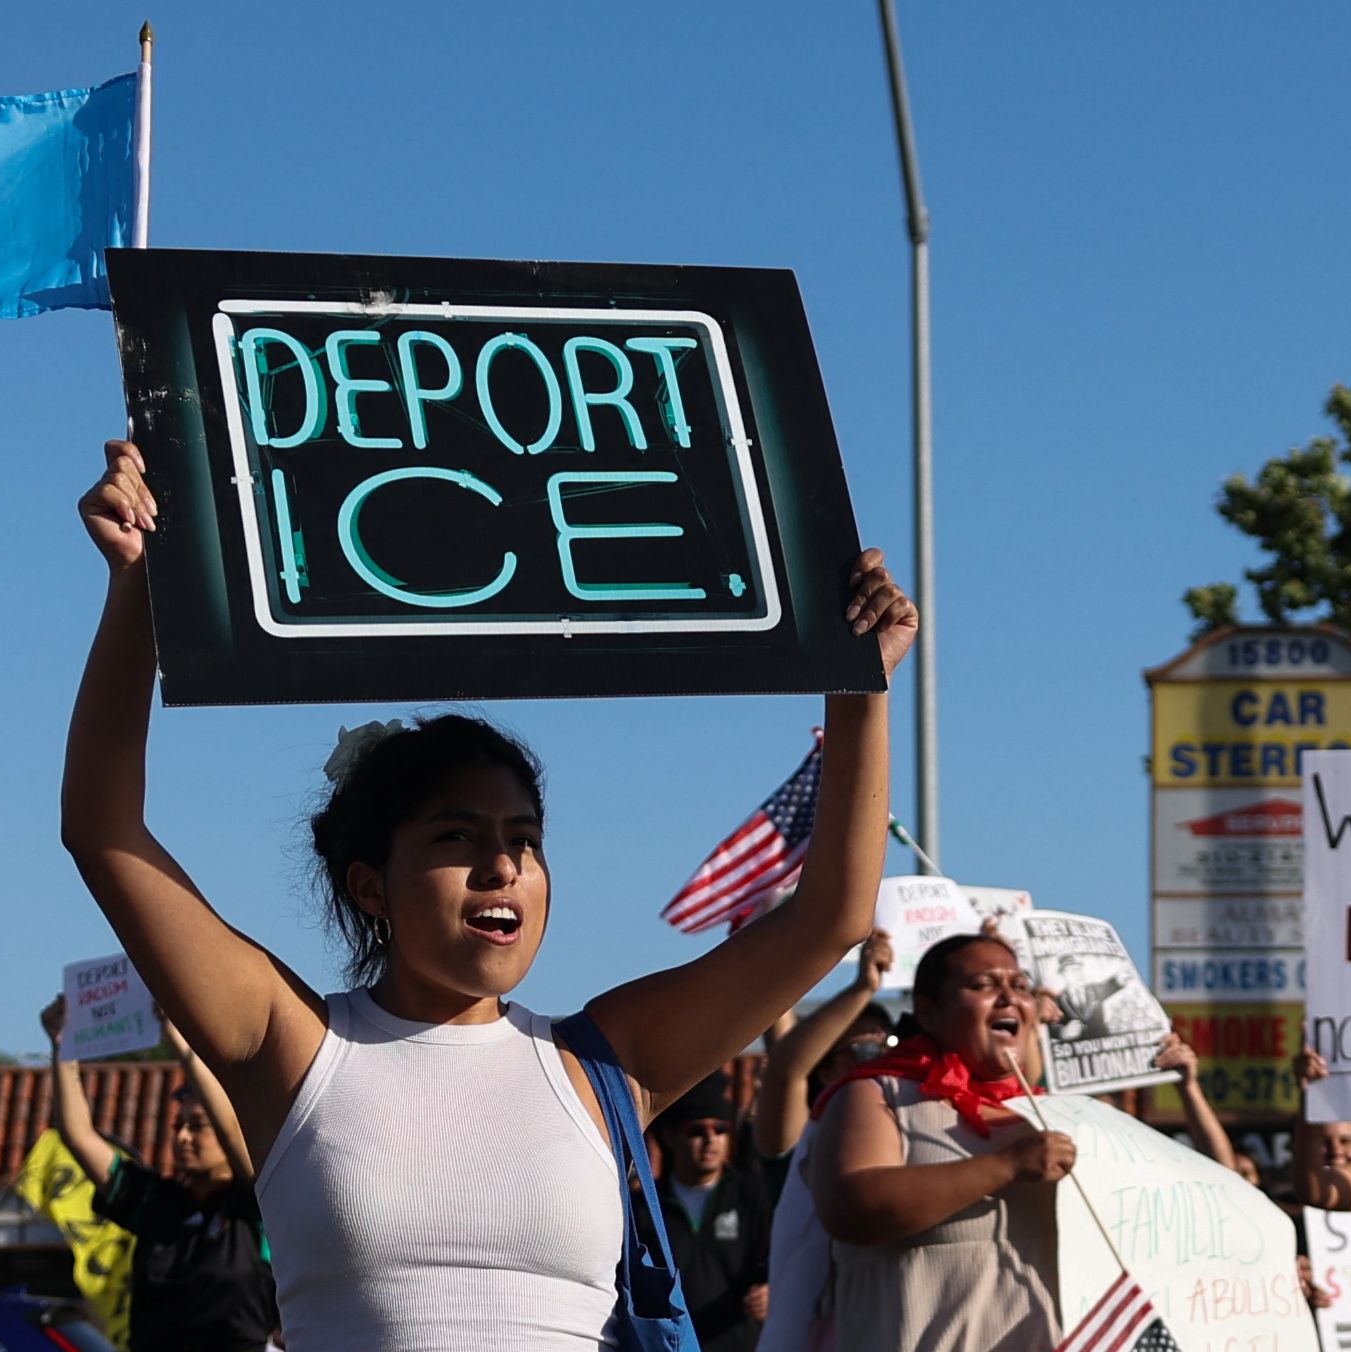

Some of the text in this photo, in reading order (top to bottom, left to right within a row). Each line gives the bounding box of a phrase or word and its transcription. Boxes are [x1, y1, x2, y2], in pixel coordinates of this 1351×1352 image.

[240, 327, 698, 456] DEPORT
[271, 465, 747, 609] ICE.
[1228, 638, 1331, 667] 15800
[1230, 690, 1327, 728] CAR
[1162, 957, 1289, 992] SMOKERS
[1110, 1181, 1266, 1265] FAMILIES
